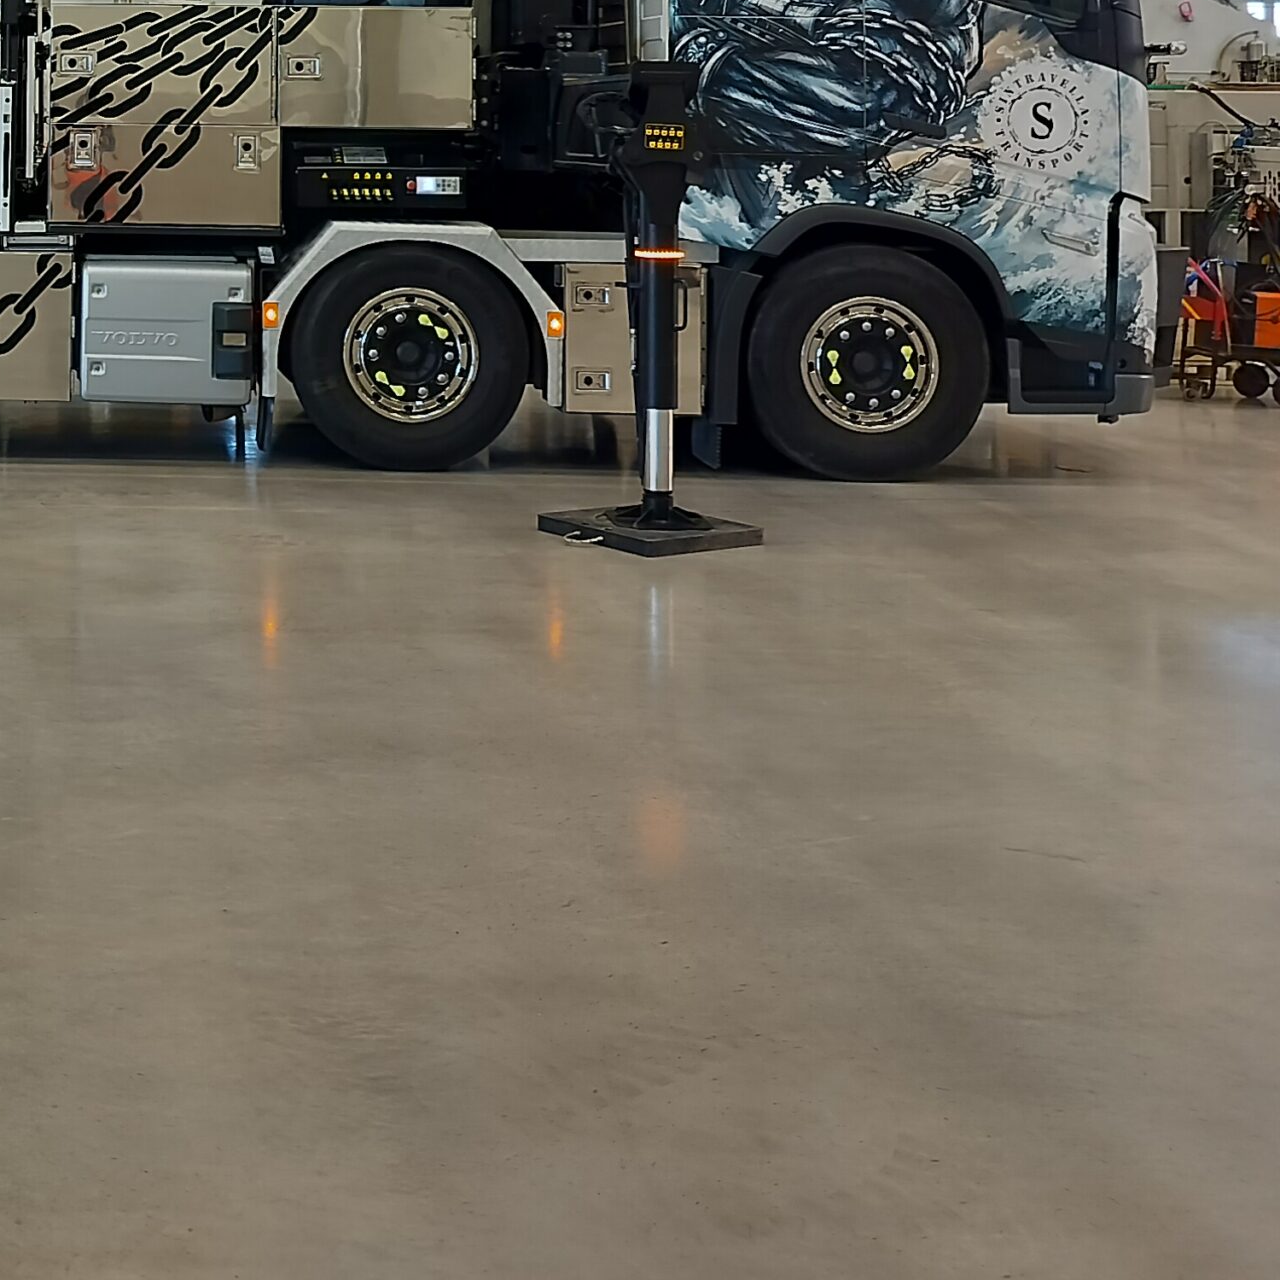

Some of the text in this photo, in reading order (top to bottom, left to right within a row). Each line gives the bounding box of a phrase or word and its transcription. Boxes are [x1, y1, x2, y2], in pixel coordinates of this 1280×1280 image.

[994, 72, 1089, 116] SINTRAVELLA
[1031, 102, 1054, 140] S
[995, 130, 1089, 170] TRANSPORT
[91, 330, 179, 346] VOLVO
